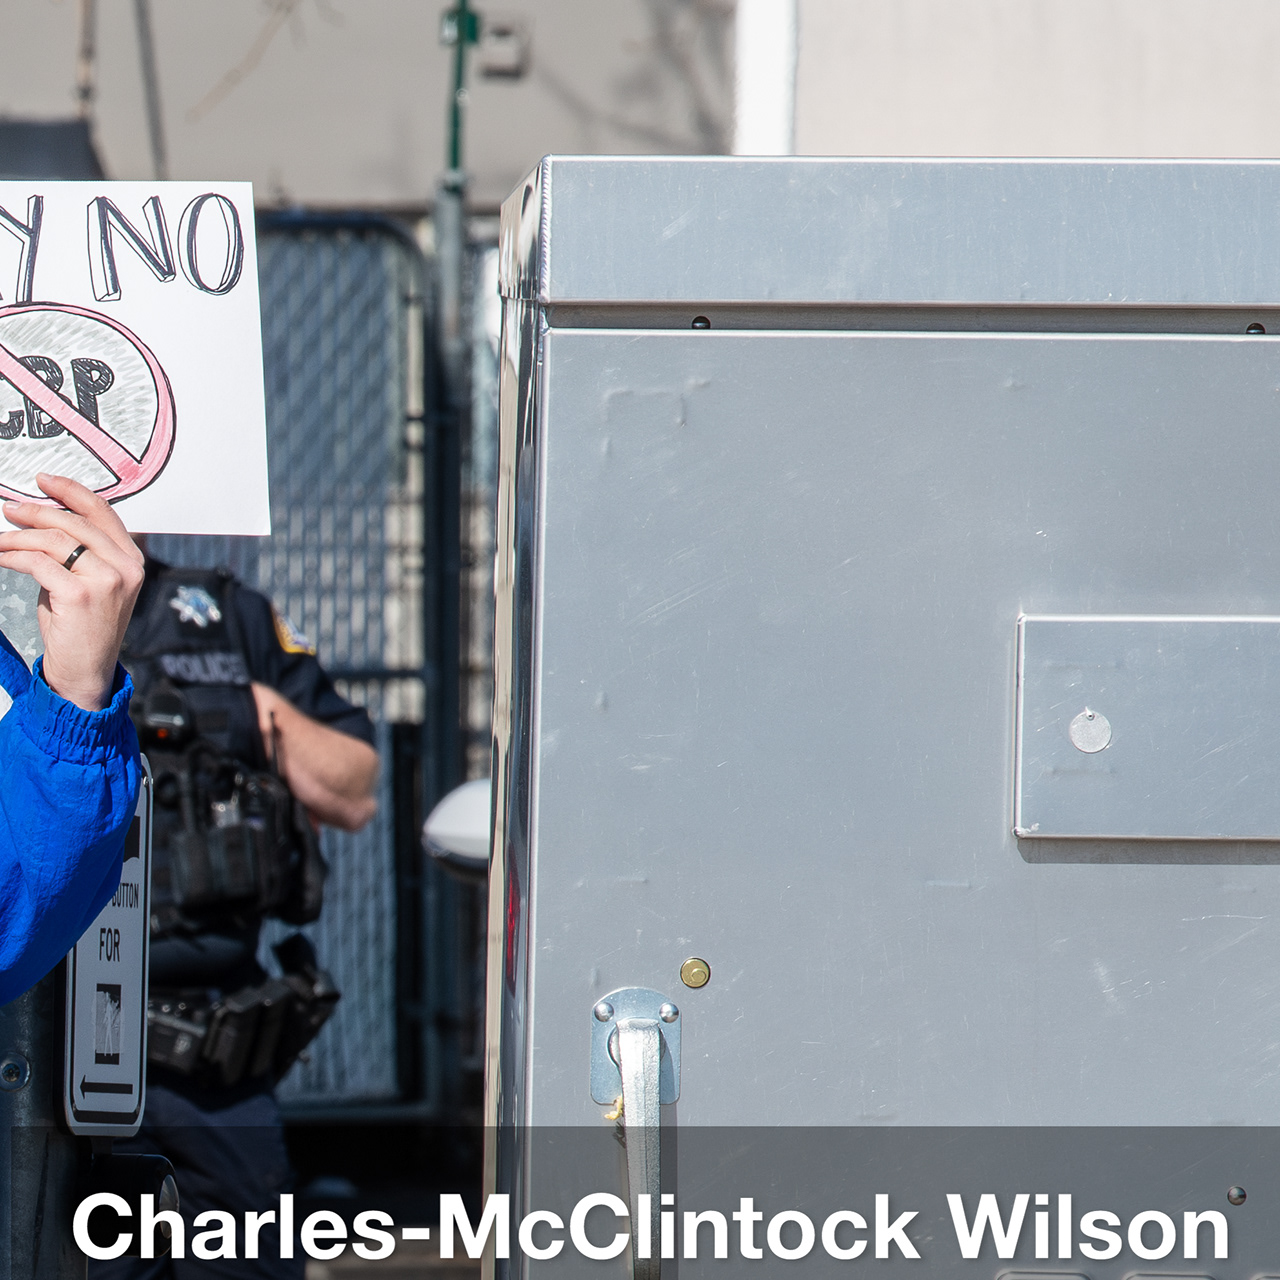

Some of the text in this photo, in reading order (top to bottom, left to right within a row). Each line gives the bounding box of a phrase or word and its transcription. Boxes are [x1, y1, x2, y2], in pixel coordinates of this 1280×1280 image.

[87, 192, 244, 302] NO
[160, 652, 249, 685] POLICE
[99, 928, 121, 962] FOR
